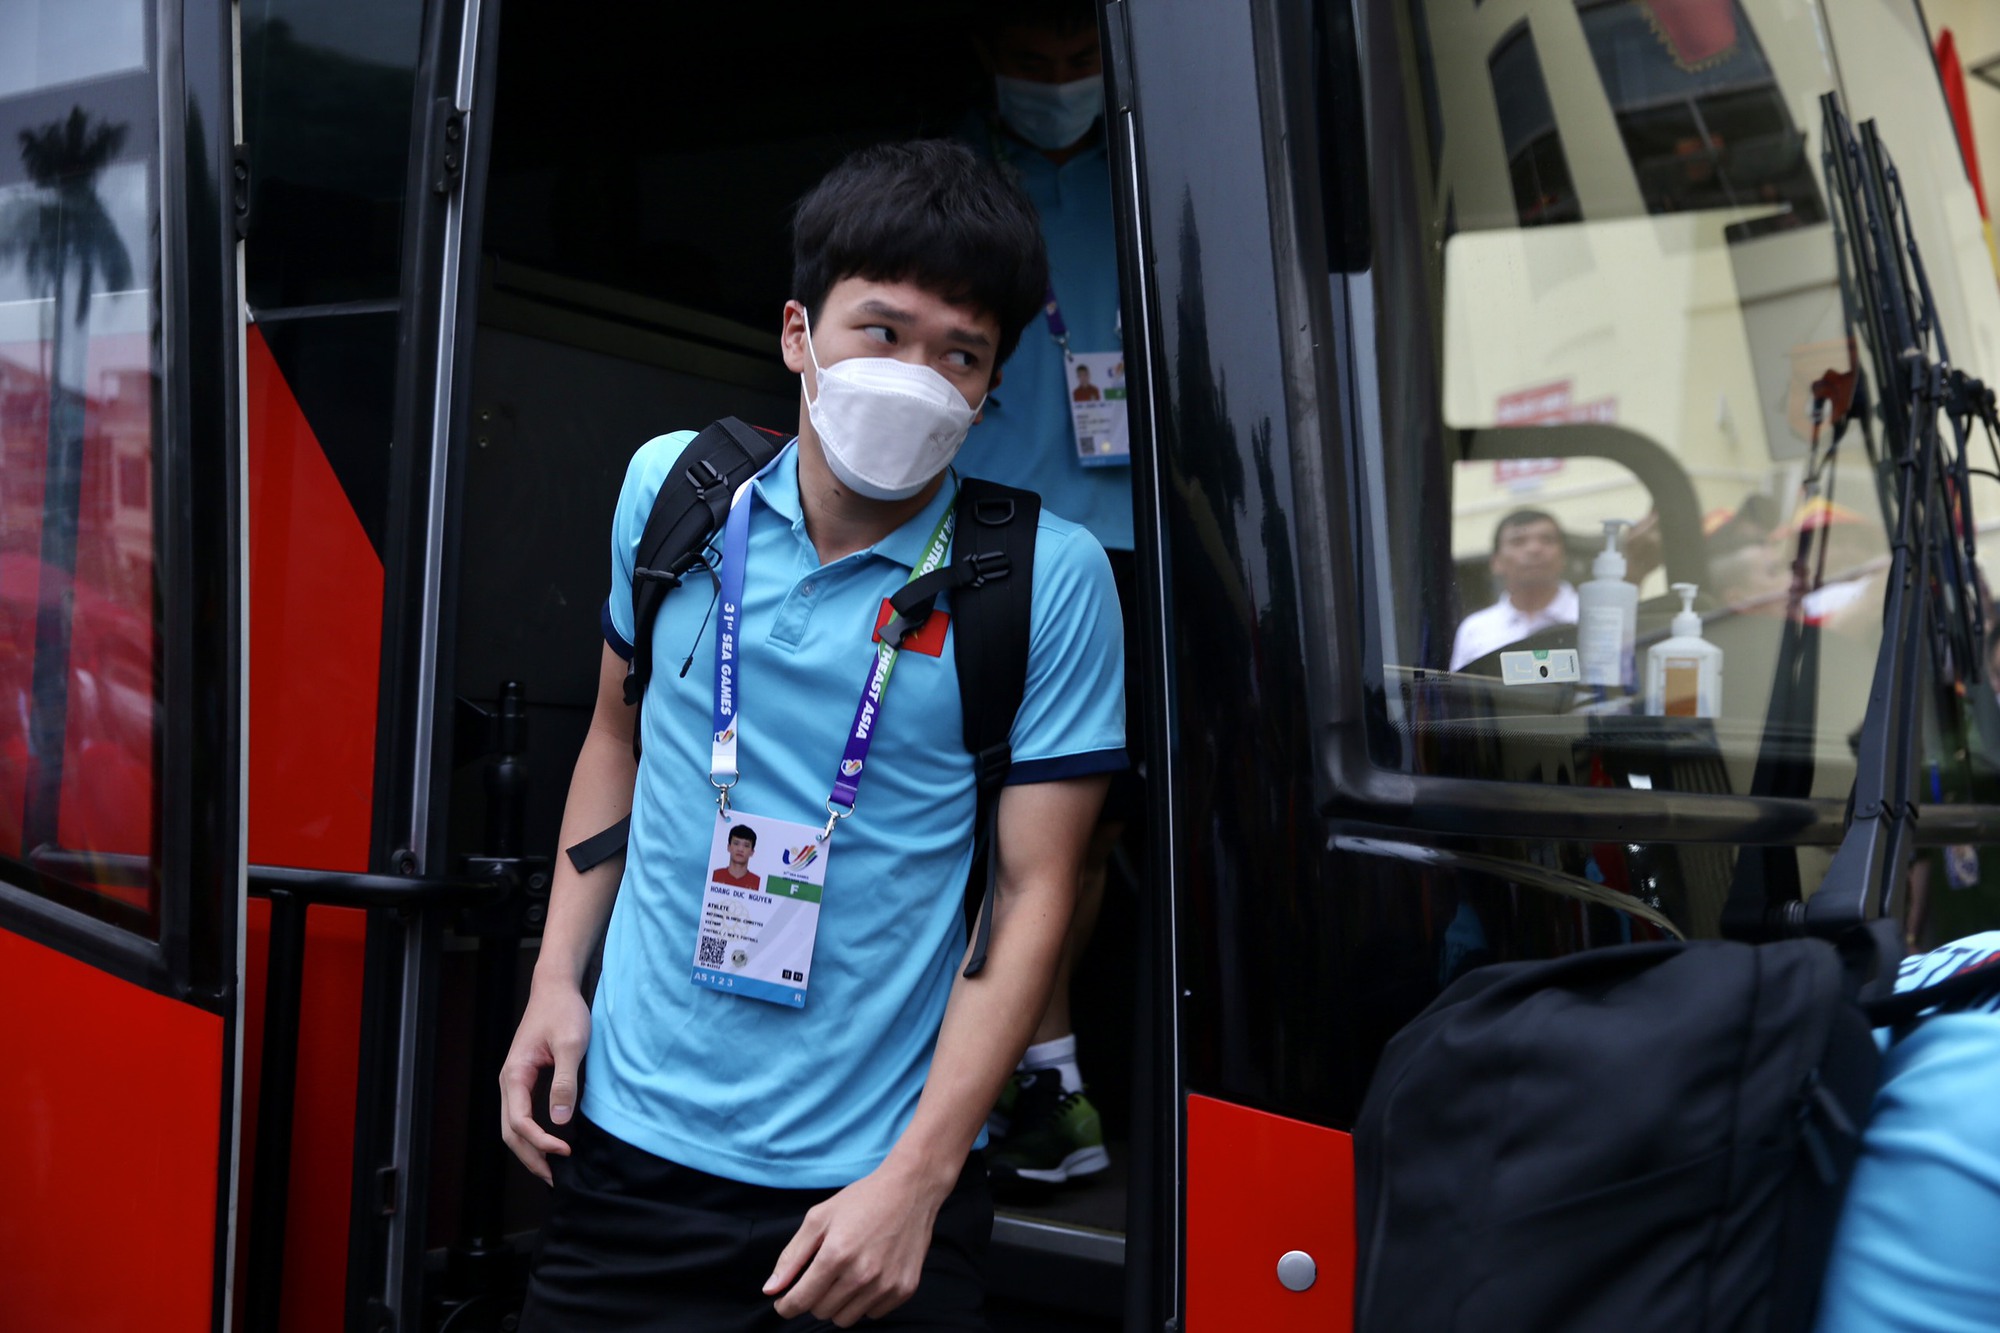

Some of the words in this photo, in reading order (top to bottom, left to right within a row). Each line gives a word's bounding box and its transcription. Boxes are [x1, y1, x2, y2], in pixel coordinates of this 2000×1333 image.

[938, 529, 948, 543] A
[721, 633, 733, 660] SEA
[868, 643, 895, 703] THEAST
[720, 664, 732, 716] GAMES
[855, 700, 875, 739] ASIA
[710, 886, 730, 896] HOANG
[733, 890, 745, 899] DUC
[748, 893, 772, 904] NGUYEN
[790, 884, 799, 895] F
[707, 902, 729, 911] ATHLETE
[693, 972, 708, 982] AS
[718, 977, 725, 986] 2
[727, 978, 734, 987] 3
